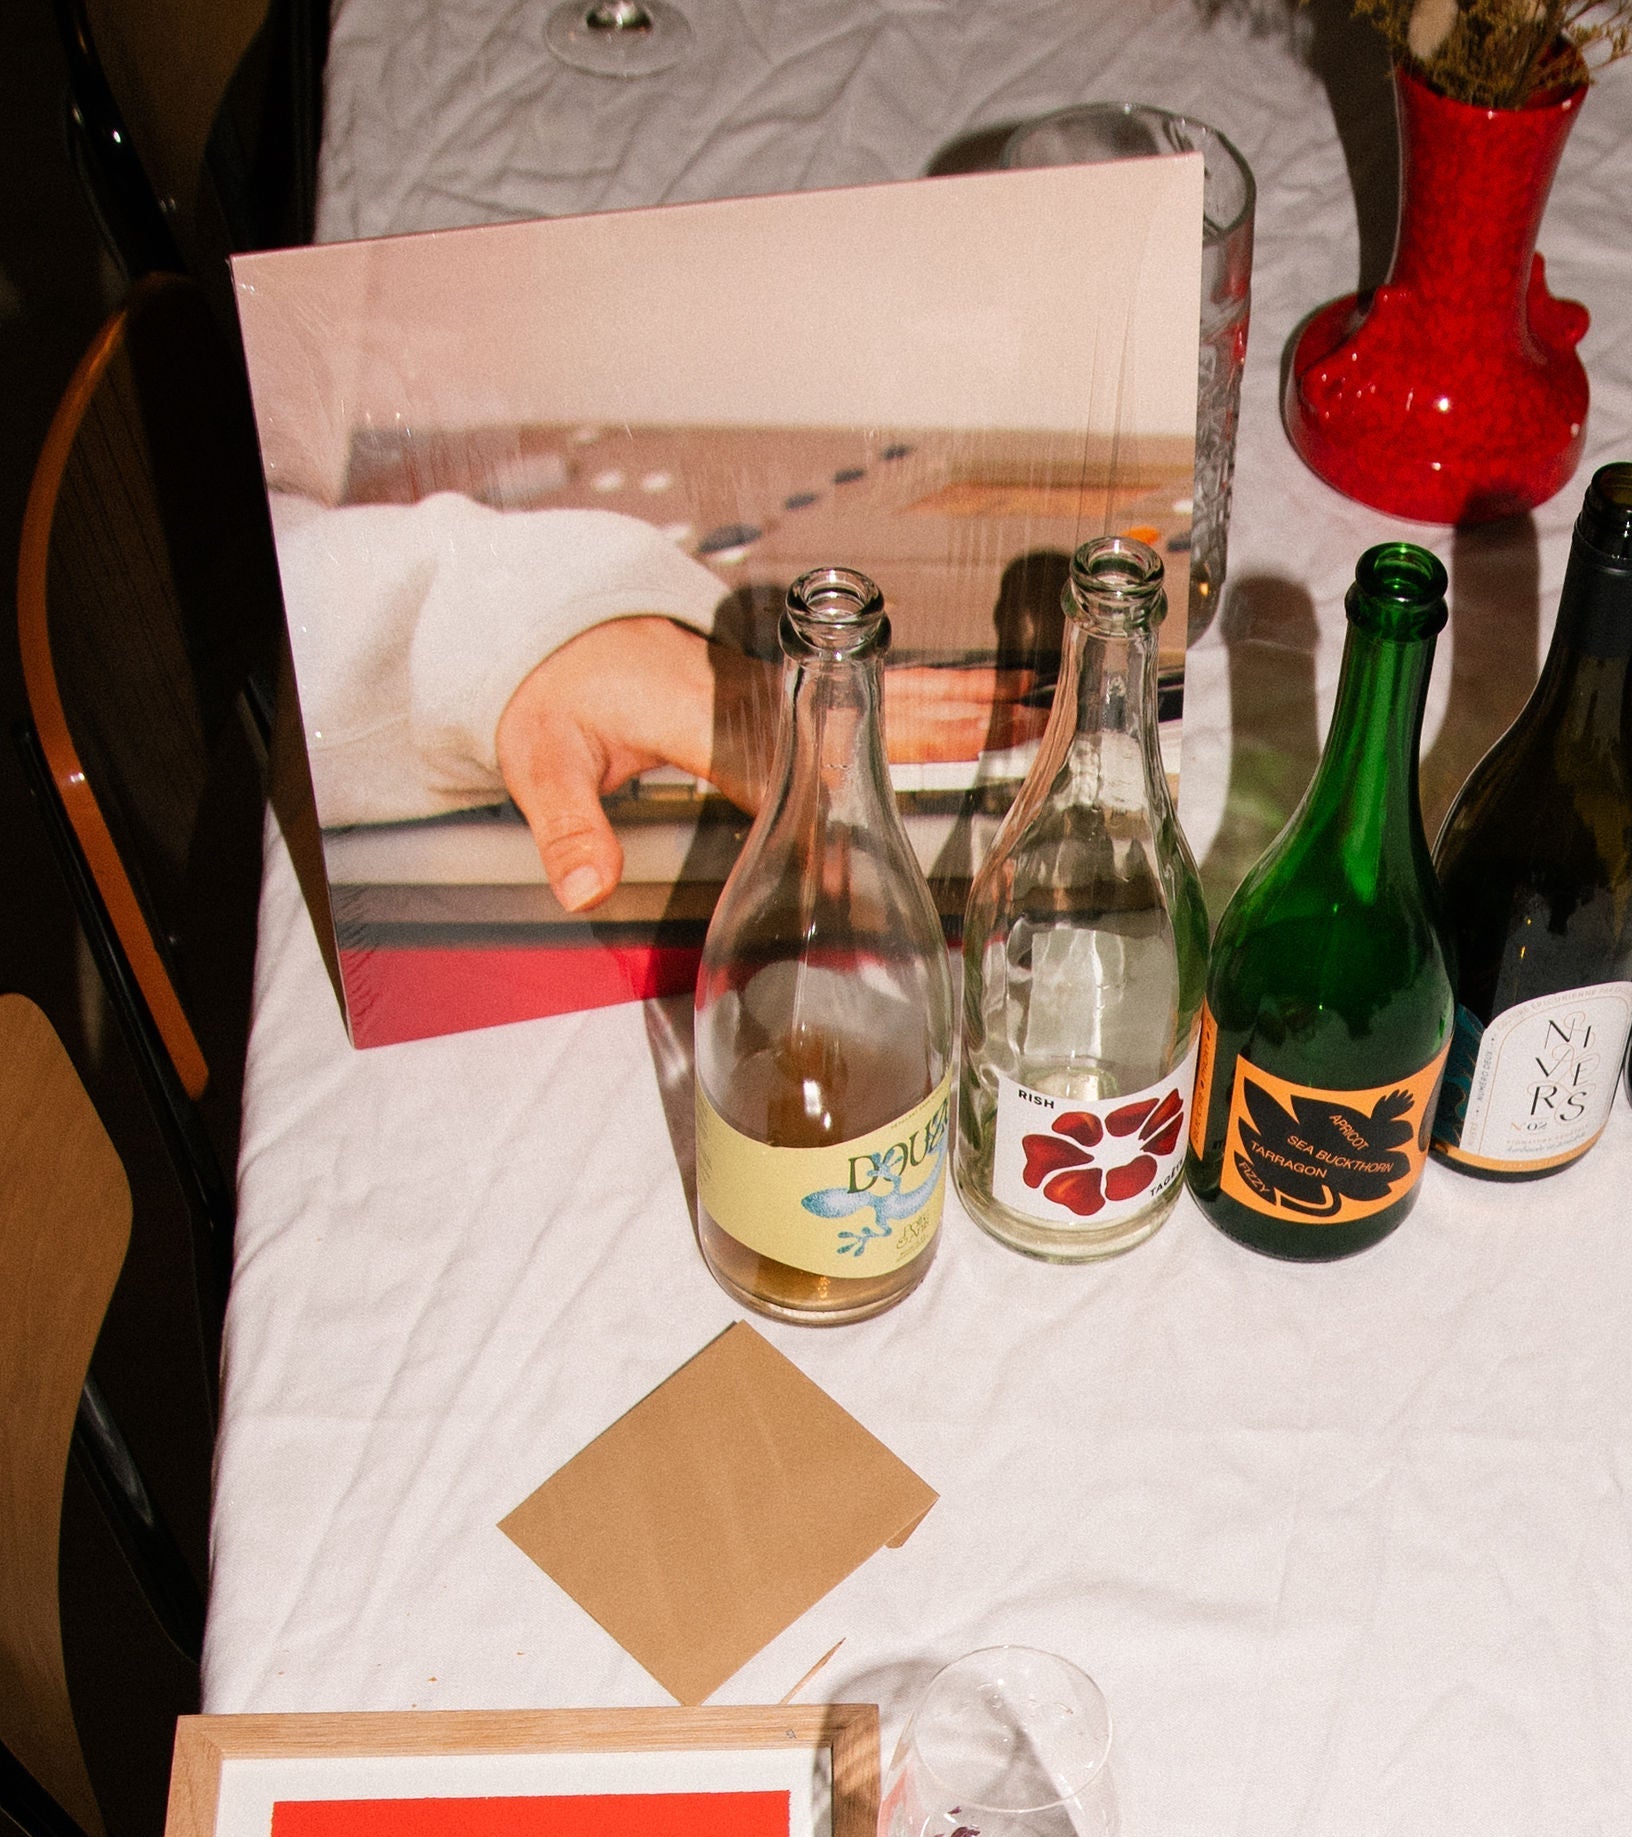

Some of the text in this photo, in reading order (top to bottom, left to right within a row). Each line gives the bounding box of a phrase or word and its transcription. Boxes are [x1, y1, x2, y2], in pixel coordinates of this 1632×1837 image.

[1018, 1089, 1055, 1110] RISH
[1328, 1114, 1370, 1151] APRICOT
[1251, 1141, 1328, 1179] TARRAGON
[1287, 1135, 1395, 1174] SEA BUCKTHORN
[1238, 1161, 1271, 1194] FIZZY
